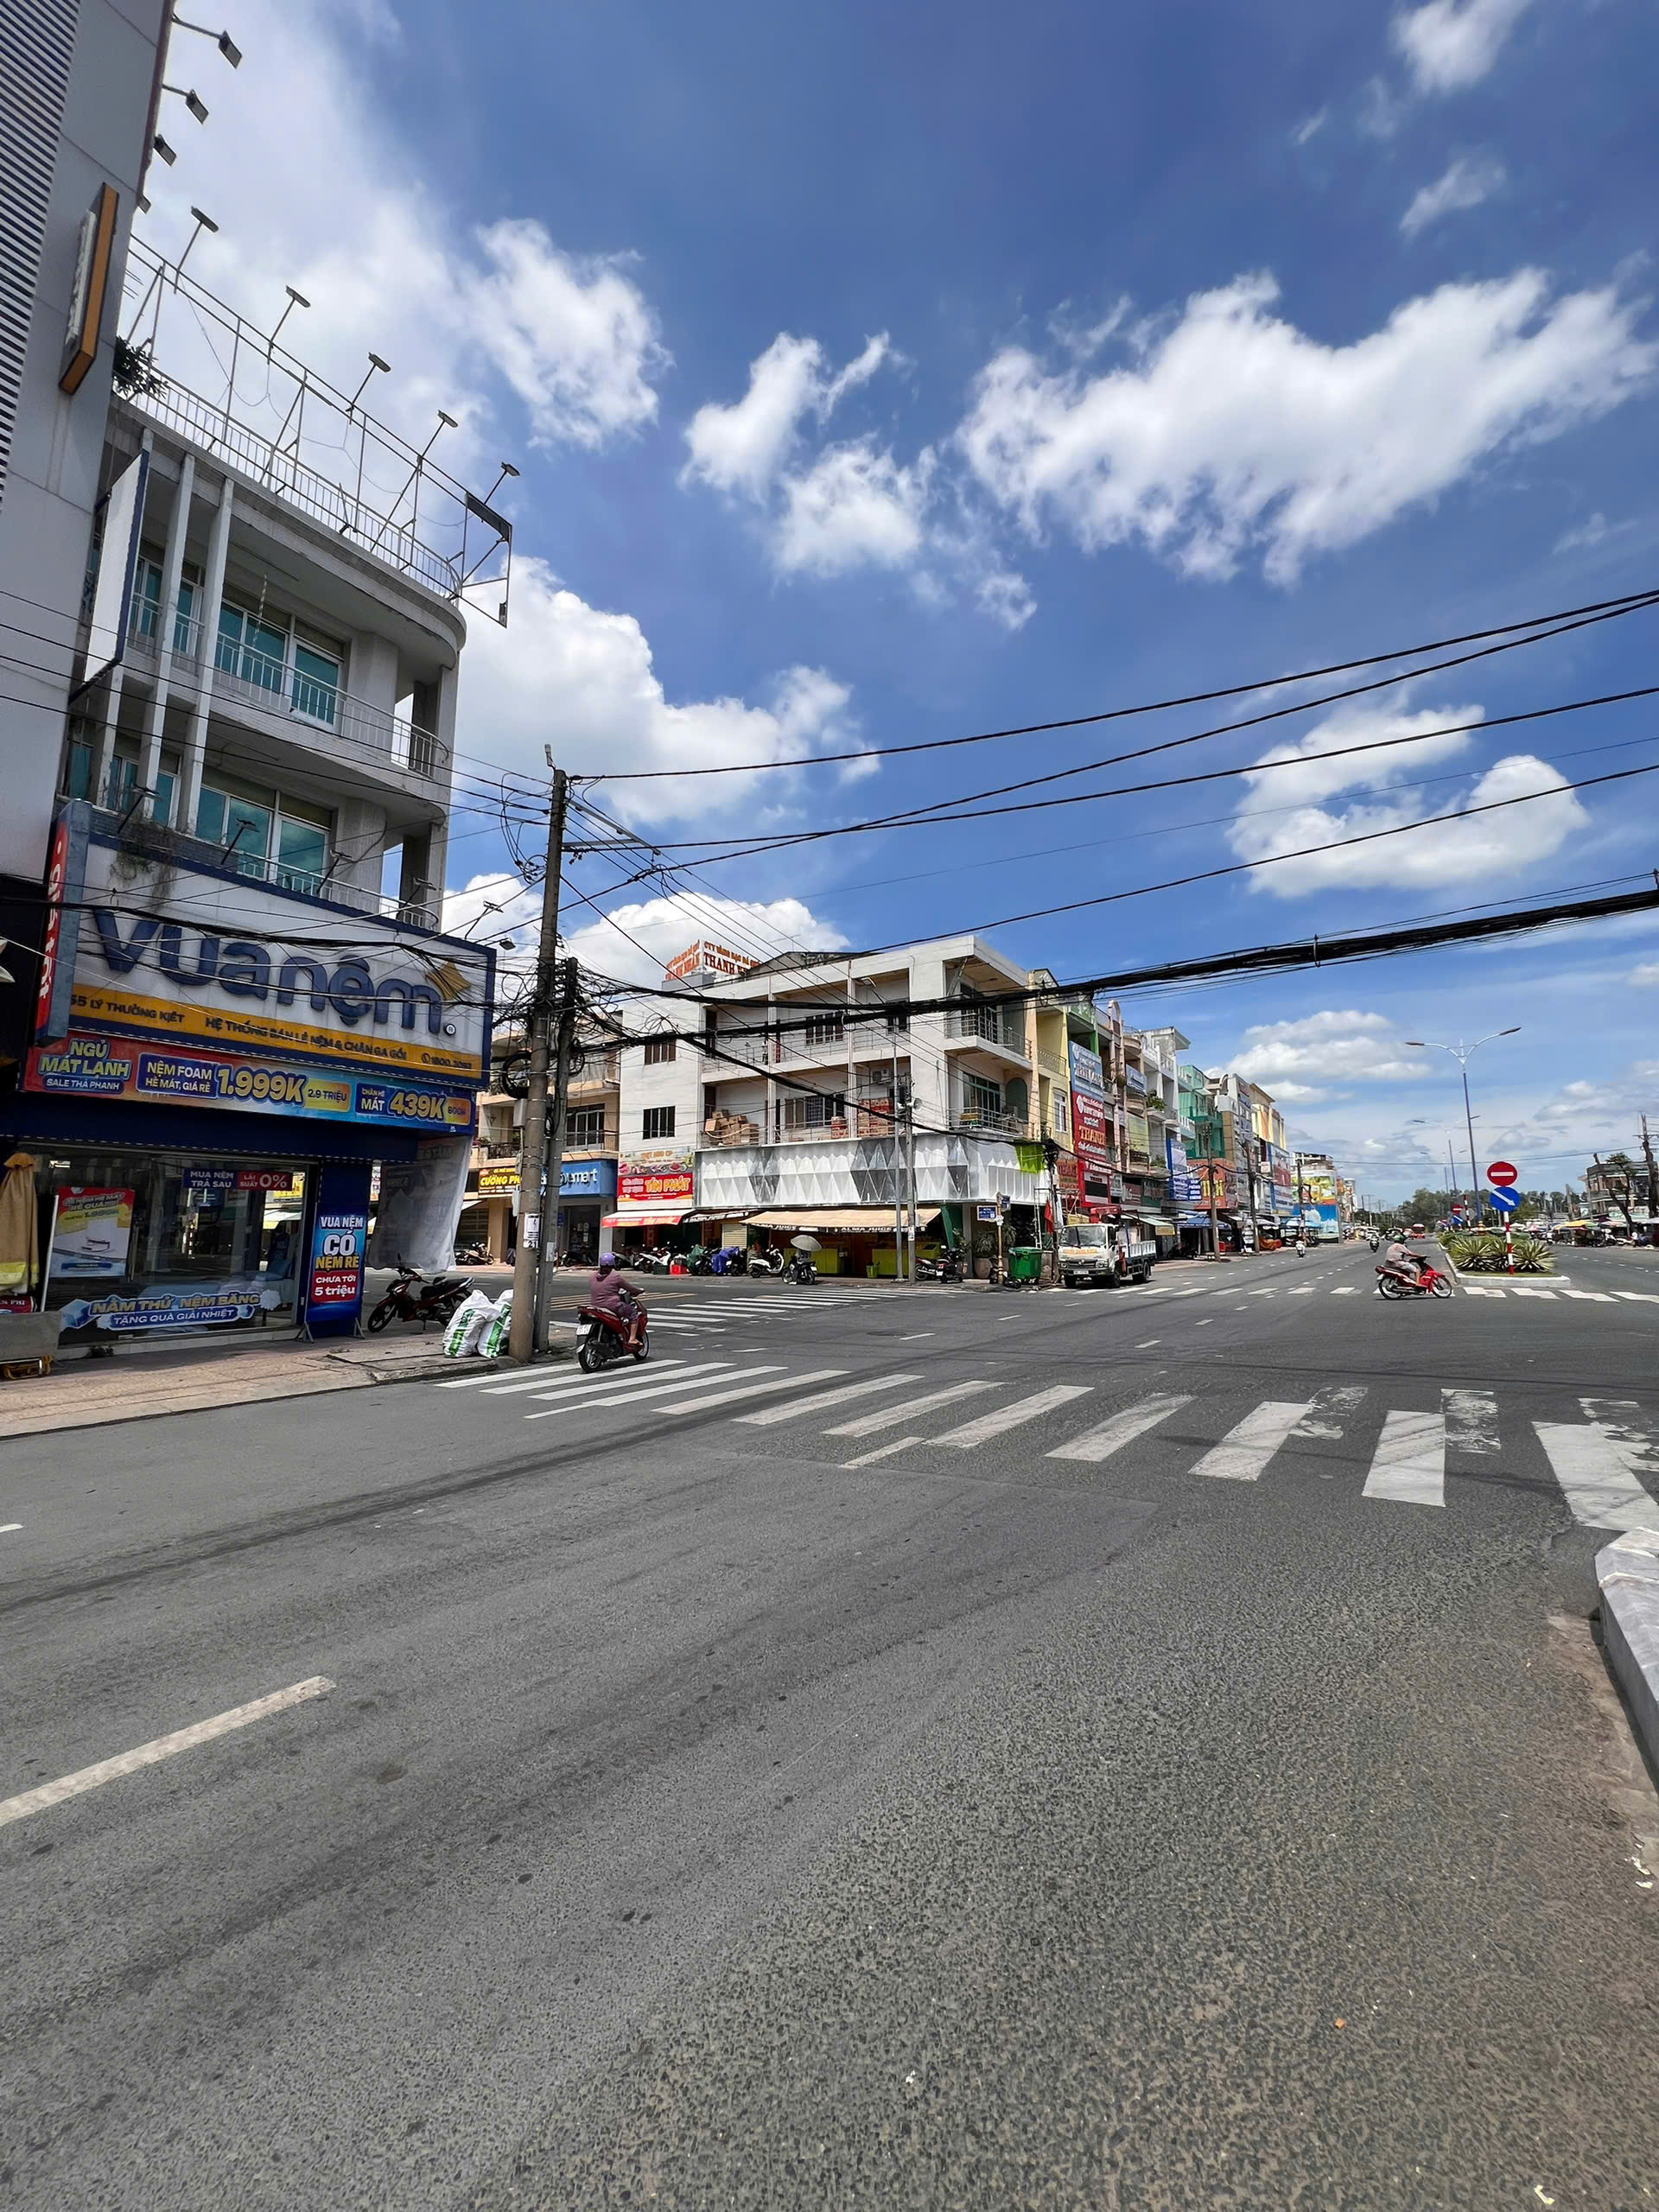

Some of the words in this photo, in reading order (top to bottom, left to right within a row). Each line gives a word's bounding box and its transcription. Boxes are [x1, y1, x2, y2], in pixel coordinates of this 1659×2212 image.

[70, 1039, 108, 1057] NGỦ
[41, 1052, 80, 1072] MÁT
[82, 1059, 130, 1078] LẠNH
[147, 1060, 175, 1077] NỆM
[177, 1065, 212, 1080] FOAM
[47, 1077, 69, 1088] SALE
[90, 1081, 119, 1090] PHANH
[145, 1077, 159, 1088] HÈ
[182, 1080, 199, 1091] GIÁ
[218, 1068, 305, 1102] 1.999K
[308, 1089, 321, 1098] 2.9
[322, 1090, 347, 1103] TRIỆU
[361, 1097, 385, 1112] MÁT
[390, 1091, 444, 1119] 439K
[213, 1170, 234, 1179] NỆM
[259, 1173, 287, 1189] 0%
[191, 1179, 211, 1188] TRẢ
[645, 1177, 663, 1192] TÍN
[664, 1175, 690, 1192] PHÁT
[321, 1217, 340, 1227] VUA
[341, 1216, 363, 1230] NỆM
[323, 1230, 356, 1256] CÓ
[315, 1255, 343, 1271] NỆM
[315, 1287, 323, 1295] 5
[325, 1286, 355, 1297] triệu
[92, 1297, 136, 1313] NẰM
[179, 1295, 216, 1310] NỆM
[218, 1292, 259, 1306] BĂNG
[114, 1314, 148, 1325] TẶNG
[149, 1312, 174, 1322] QUÀ
[177, 1310, 199, 1320] GIẢI
[201, 1308, 234, 1319] NHIỆT
